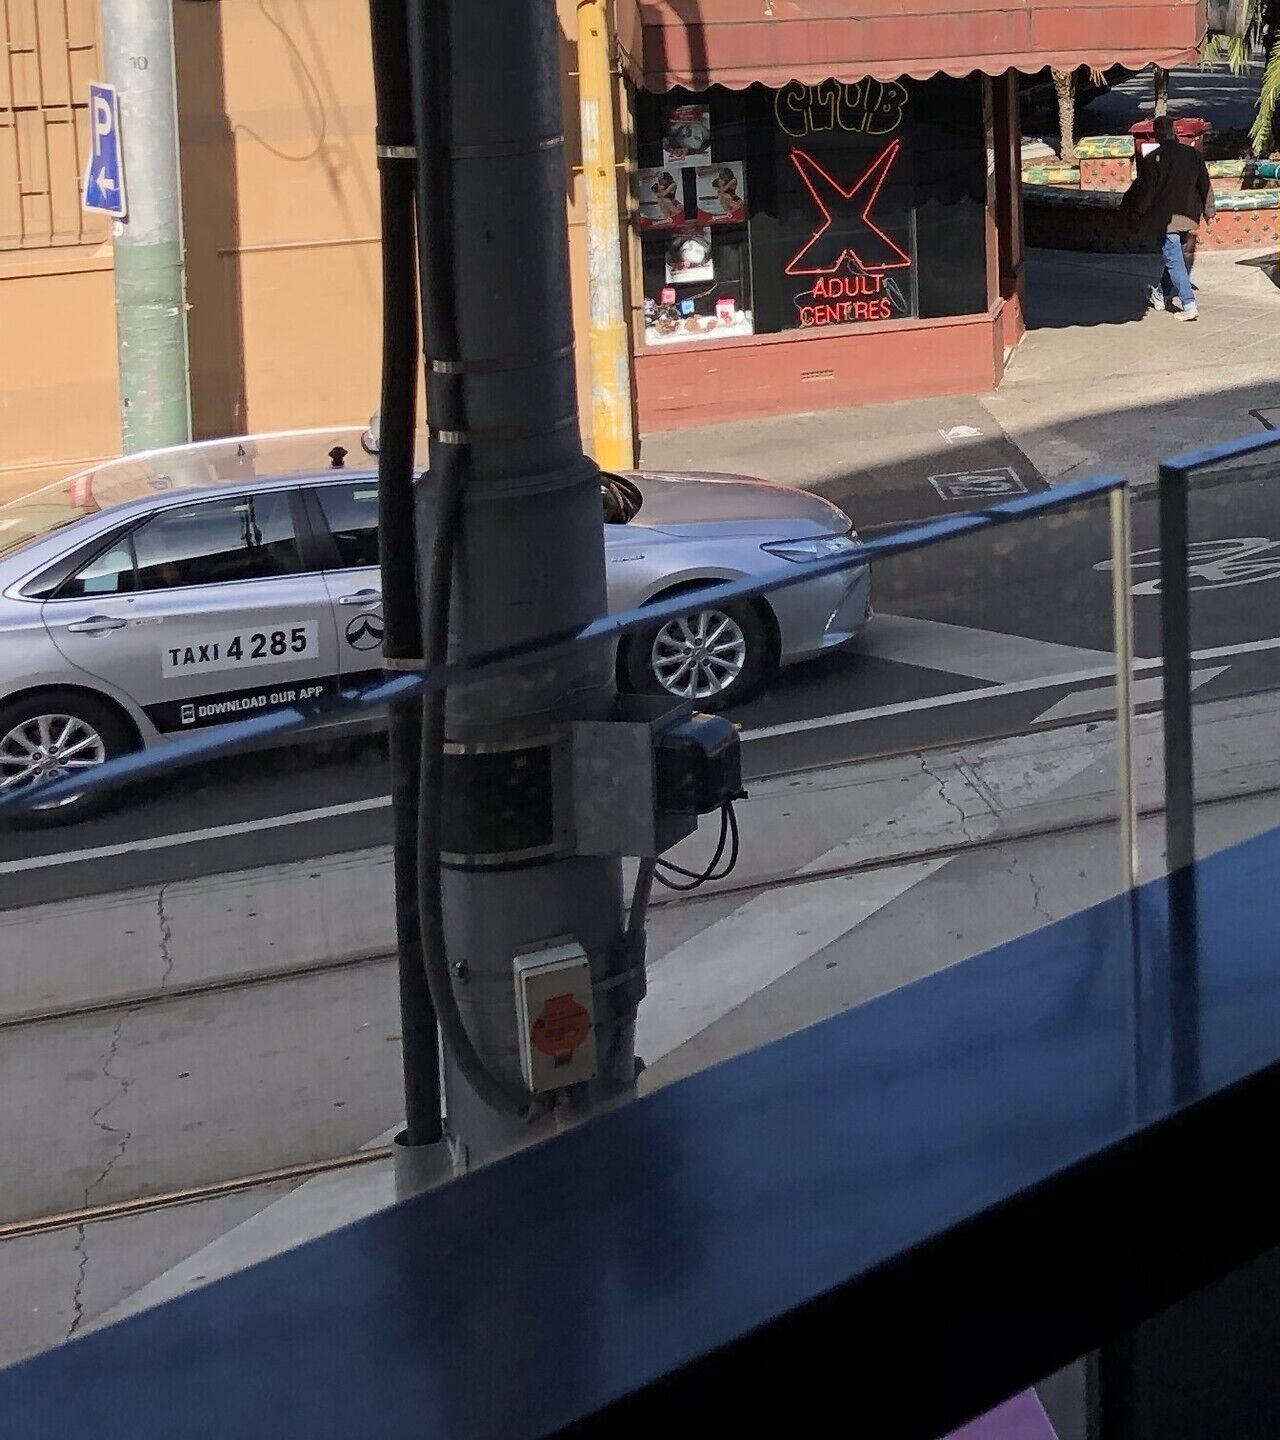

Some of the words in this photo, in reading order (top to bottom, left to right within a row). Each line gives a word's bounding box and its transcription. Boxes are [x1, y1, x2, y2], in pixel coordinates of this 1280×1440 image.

[774, 77, 909, 138] CLUB
[94, 96, 112, 157] P
[784, 139, 912, 276] X
[812, 273, 885, 299] ADULT
[799, 297, 892, 328] CENTRES
[168, 643, 220, 666] TAXI
[198, 695, 267, 717] DOWNLOAD
[270, 689, 297, 705] OUR
[299, 685, 324, 700] APP
